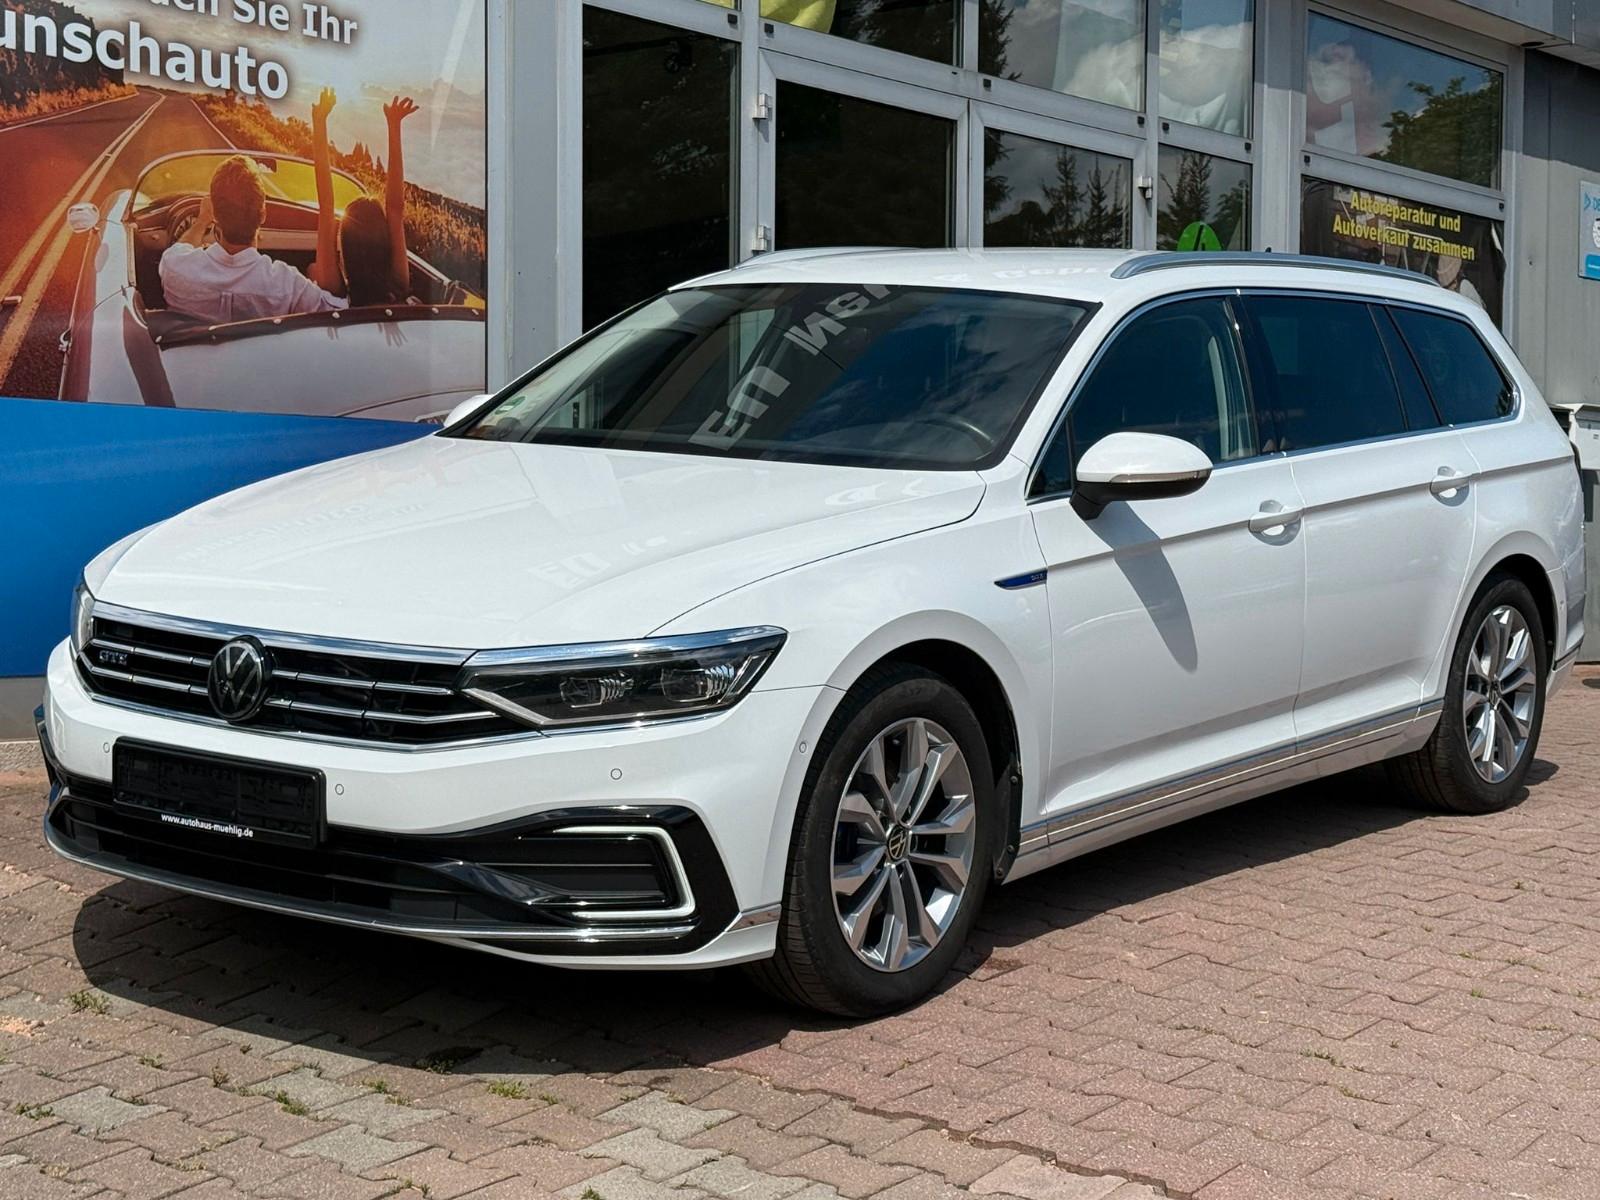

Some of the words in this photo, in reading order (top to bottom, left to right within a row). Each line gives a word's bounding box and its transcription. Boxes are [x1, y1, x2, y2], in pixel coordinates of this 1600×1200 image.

[233, 0, 290, 31] Sie
[302, 3, 358, 45] Ihr
[1350, 191, 1437, 227] Autoreparatur
[1440, 215, 1461, 233] und
[1333, 214, 1410, 248] Autoverkauf
[1413, 234, 1475, 260] zusammen
[161, 814, 254, 838] www.autohaus-muehlig.de
